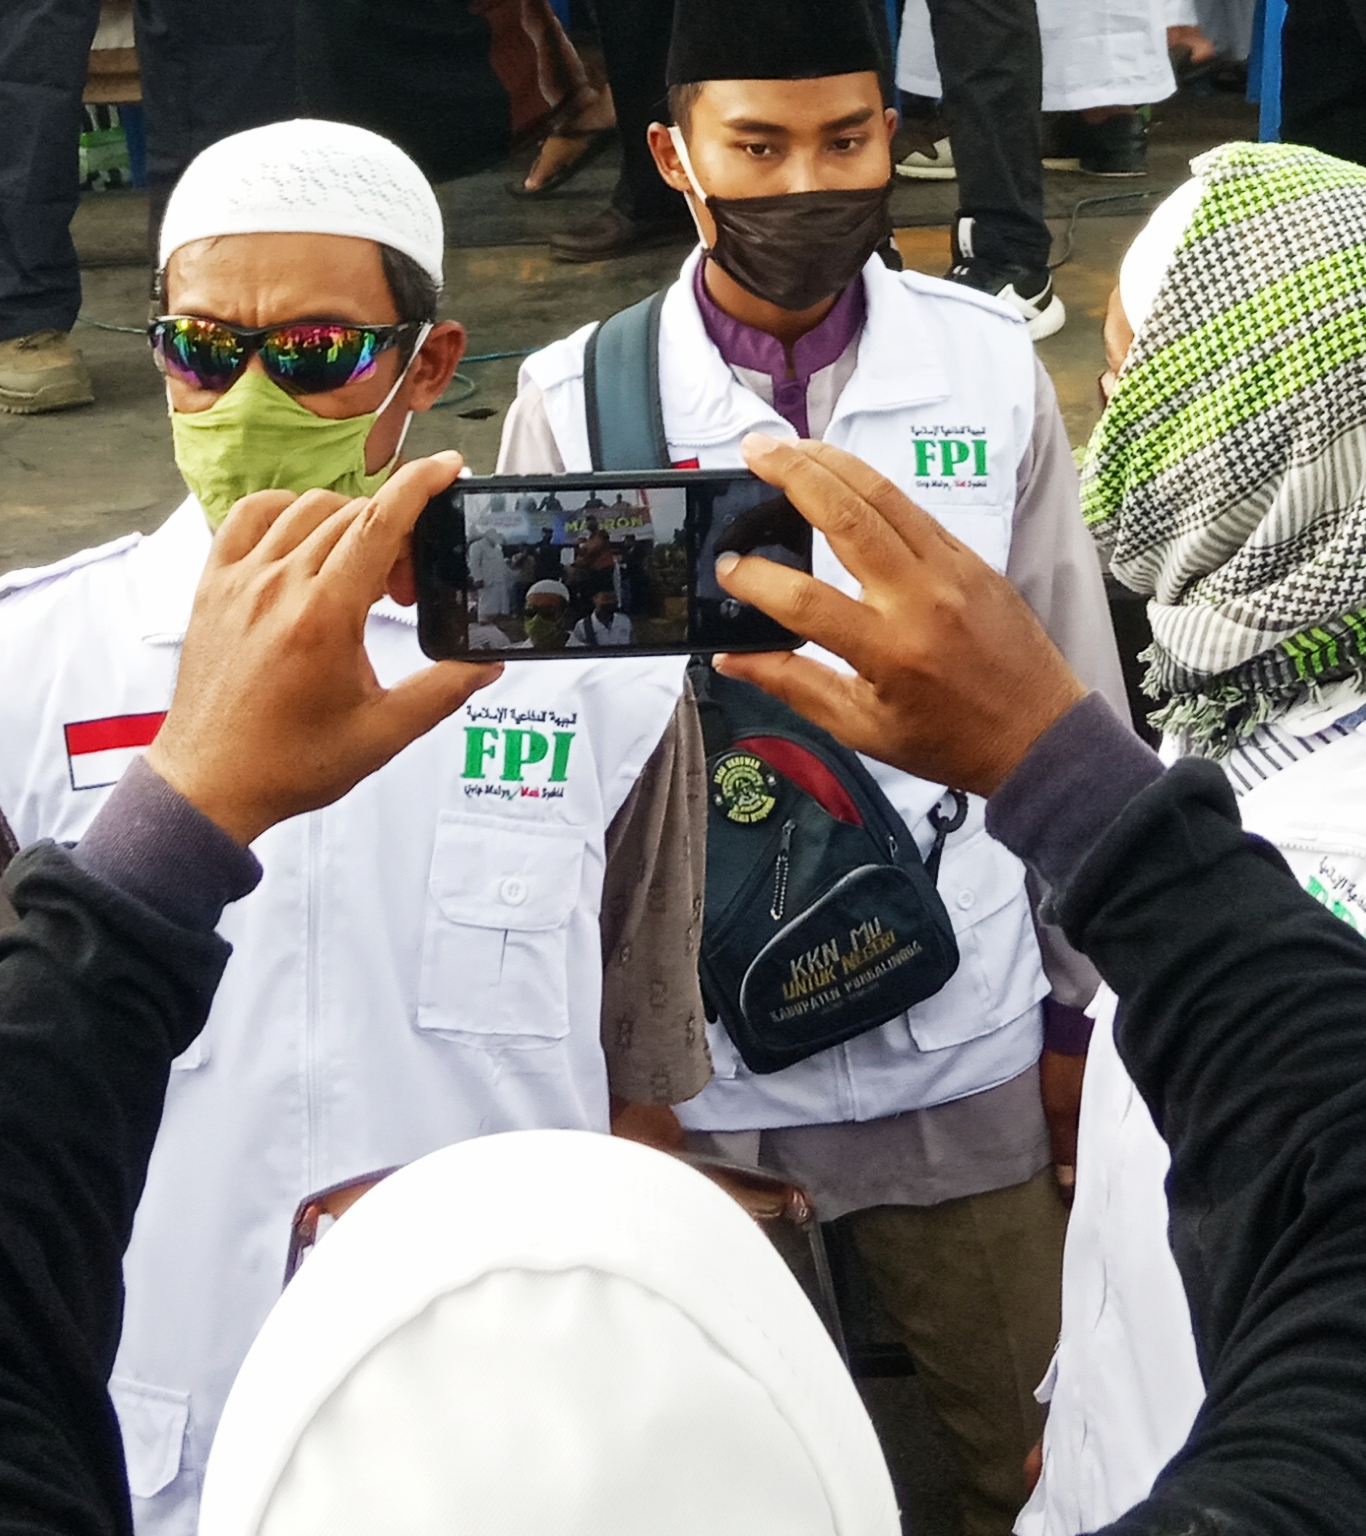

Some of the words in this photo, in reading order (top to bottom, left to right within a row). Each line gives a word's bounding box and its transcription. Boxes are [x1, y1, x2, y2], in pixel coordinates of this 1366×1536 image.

[912, 439, 989, 477] FPI
[460, 726, 576, 782] FPI
[782, 969, 837, 1000] UNTUK
[840, 928, 897, 975] NEGERI
[790, 938, 841, 981] KKN
[850, 916, 883, 951] MU
